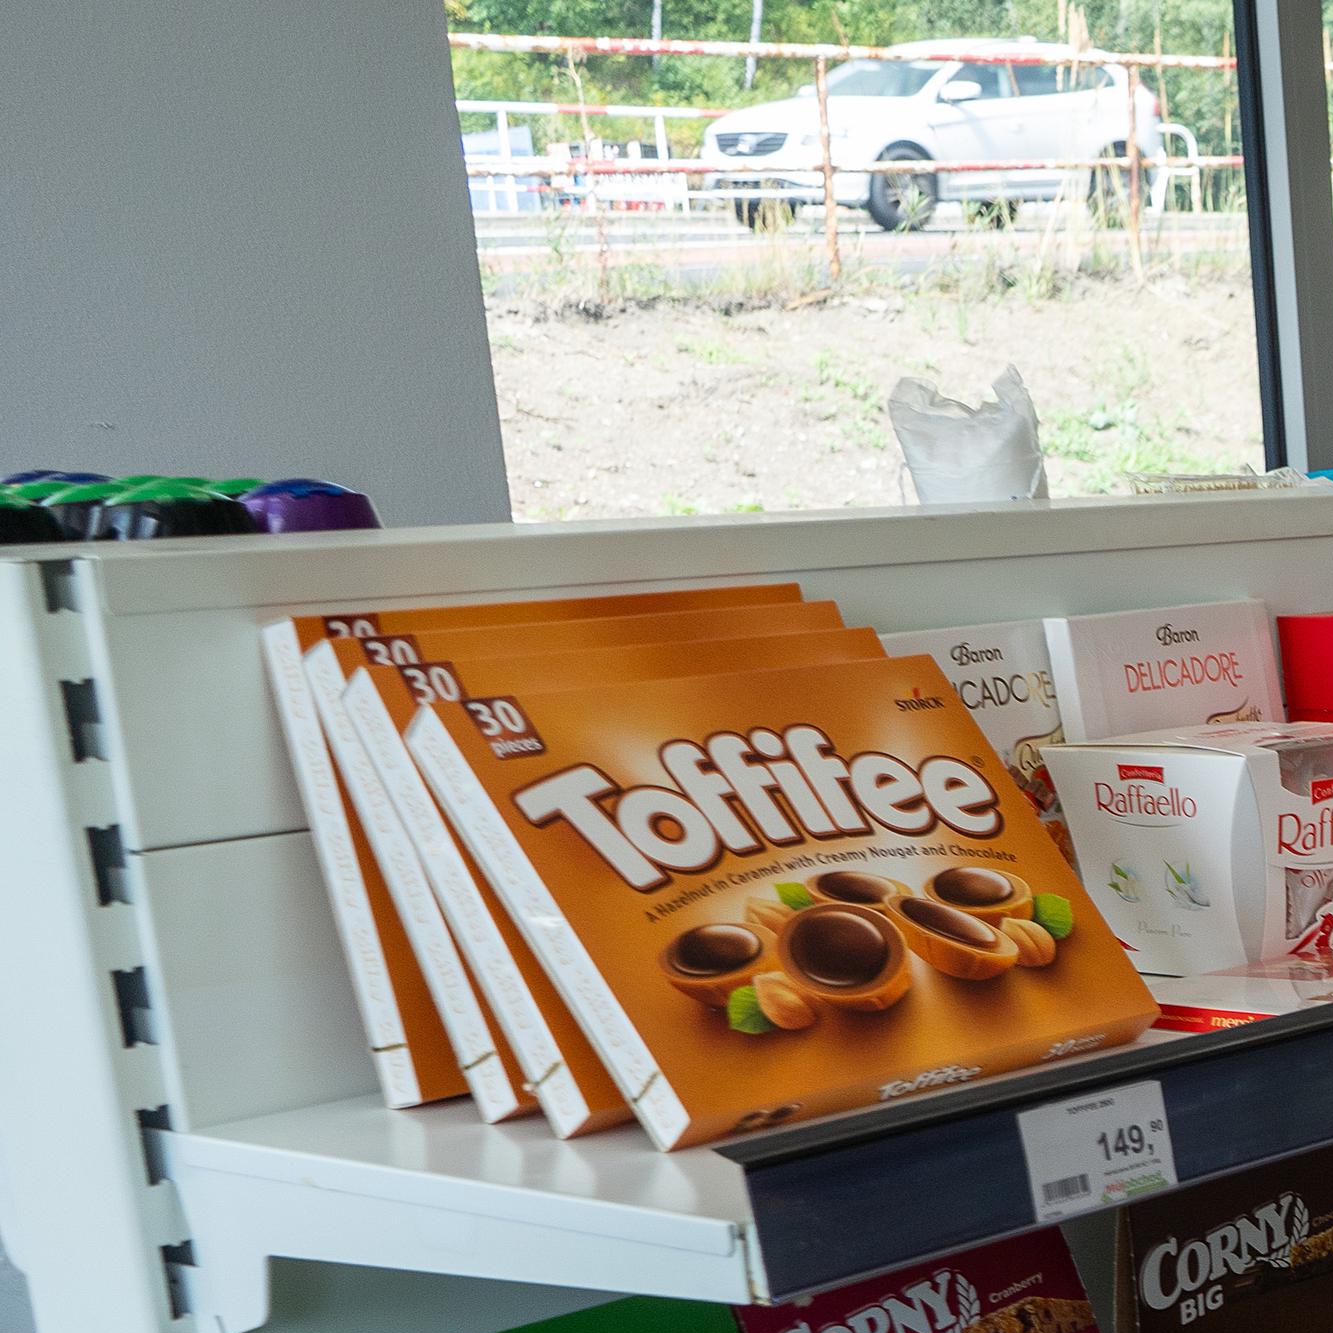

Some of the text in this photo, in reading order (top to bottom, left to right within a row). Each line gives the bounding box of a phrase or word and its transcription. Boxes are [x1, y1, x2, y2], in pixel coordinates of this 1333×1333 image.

[1156, 623, 1200, 646] Baron
[950, 642, 1003, 667] Baron
[1124, 651, 1244, 695] DELICADORE
[402, 666, 461, 705] 30
[896, 692, 946, 712] STORCK
[956, 671, 1056, 712] CADORE
[468, 700, 526, 737] 30
[489, 736, 545, 758] pieces
[1118, 766, 1164, 783] Confetteria
[514, 724, 1003, 892] Toffifee
[1094, 782, 1198, 820] Raffaello
[645, 844, 1018, 924] A Hazelnut in Caramel with Creamy Nougat and Chocolate
[1097, 1124, 1155, 1161] 149,
[1140, 1193, 1295, 1312] CORNY
[988, 1271, 1044, 1305] Cranberry
[1179, 1284, 1224, 1326] BIG
